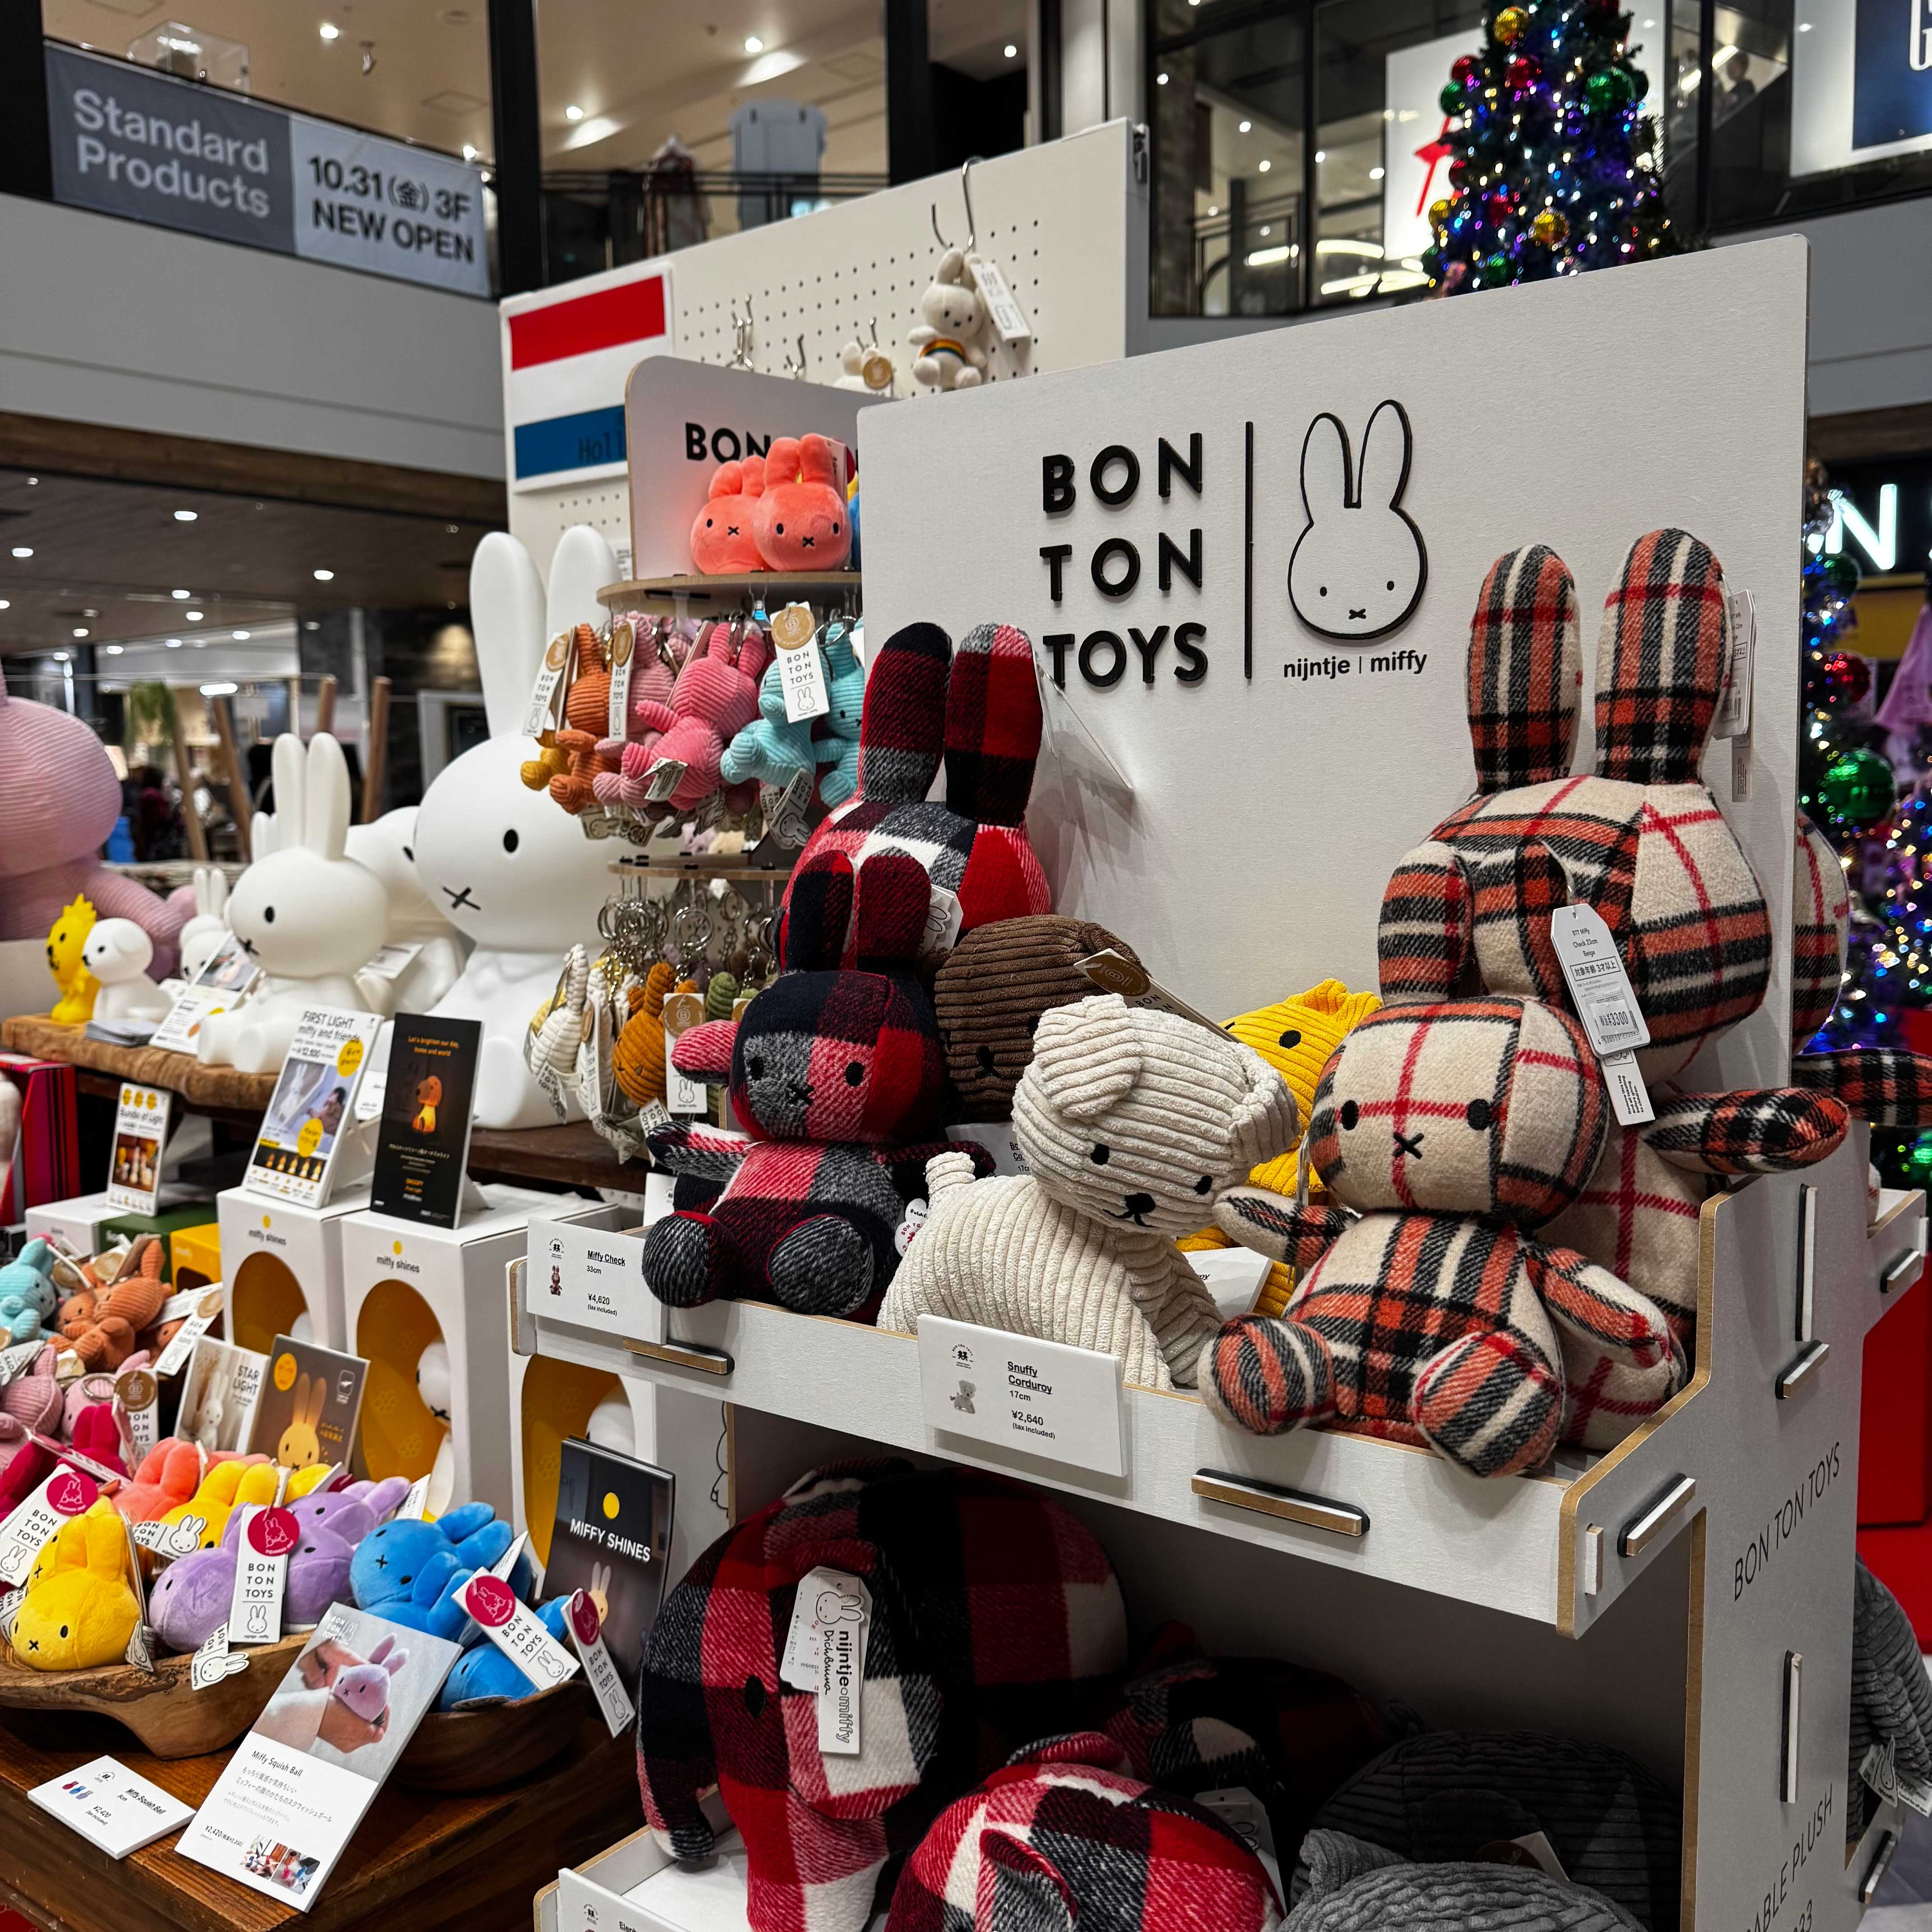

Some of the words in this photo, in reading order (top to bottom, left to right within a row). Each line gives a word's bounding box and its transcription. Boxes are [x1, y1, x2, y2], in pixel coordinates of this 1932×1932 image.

[73, 89, 269, 175] Standard
[77, 135, 271, 219] Products
[312, 198, 387, 243] NEW
[391, 222, 474, 263] OPEN
[1042, 432, 1202, 513] BON
[1039, 528, 1202, 602] TON
[787, 651, 810, 664] BON
[1042, 622, 1208, 689] TOYS
[1283, 657, 1350, 681] nijntje
[1370, 649, 1427, 674] miffy
[788, 661, 811, 674] TON
[790, 672, 814, 685] TOYS
[1135, 994, 1161, 1007] BON
[303, 1010, 328, 1024] FIRST
[327, 1015, 355, 1029] LIGHT
[654, 1105, 664, 1122] BON
[376, 1255, 395, 1270] miffy
[396, 1259, 420, 1273] shines
[587, 1250, 603, 1262] Miffy
[604, 1254, 626, 1266] Check
[586, 1265, 602, 1274] 33cm
[588, 1293, 610, 1305] ¥4,620
[596, 1305, 617, 1316] included)
[237, 1356, 260, 1381] STAR
[1007, 1361, 1038, 1377] Snuffy
[232, 1378, 259, 1396] LIGHT
[1008, 1374, 1053, 1394] Corduroy
[1009, 1390, 1031, 1401] 17cm
[1012, 1409, 1044, 1426] ¥2,640
[1012, 1422, 1025, 1431] (tax
[1026, 1425, 1056, 1440] included)
[24, 1519, 50, 1536] TON
[32, 1509, 58, 1527] BON
[1734, 1524, 1770, 1602] BON
[1775, 1483, 1804, 1550] TON
[1808, 1441, 1840, 1508] TOYS
[16, 1528, 42, 1547] TOYS
[569, 1518, 606, 1545] MIFFY
[606, 1532, 651, 1563] SHINES
[248, 1563, 276, 1572] BON
[247, 1576, 275, 1585] TON
[245, 1589, 274, 1599] TOYS
[501, 1615, 524, 1638] BON
[511, 1624, 533, 1647] TON
[520, 1634, 543, 1656] TOYS
[589, 1647, 603, 1666] BON
[836, 1630, 853, 1687] nijntje
[593, 1659, 608, 1678] TON
[599, 1671, 614, 1690] TOYS
[836, 1696, 853, 1743] miffy
[252, 1750, 268, 1764] Miffy
[268, 1757, 290, 1772] Squish
[289, 1765, 304, 1777] Ball
[1792, 1782, 1833, 1884] PLUSH
